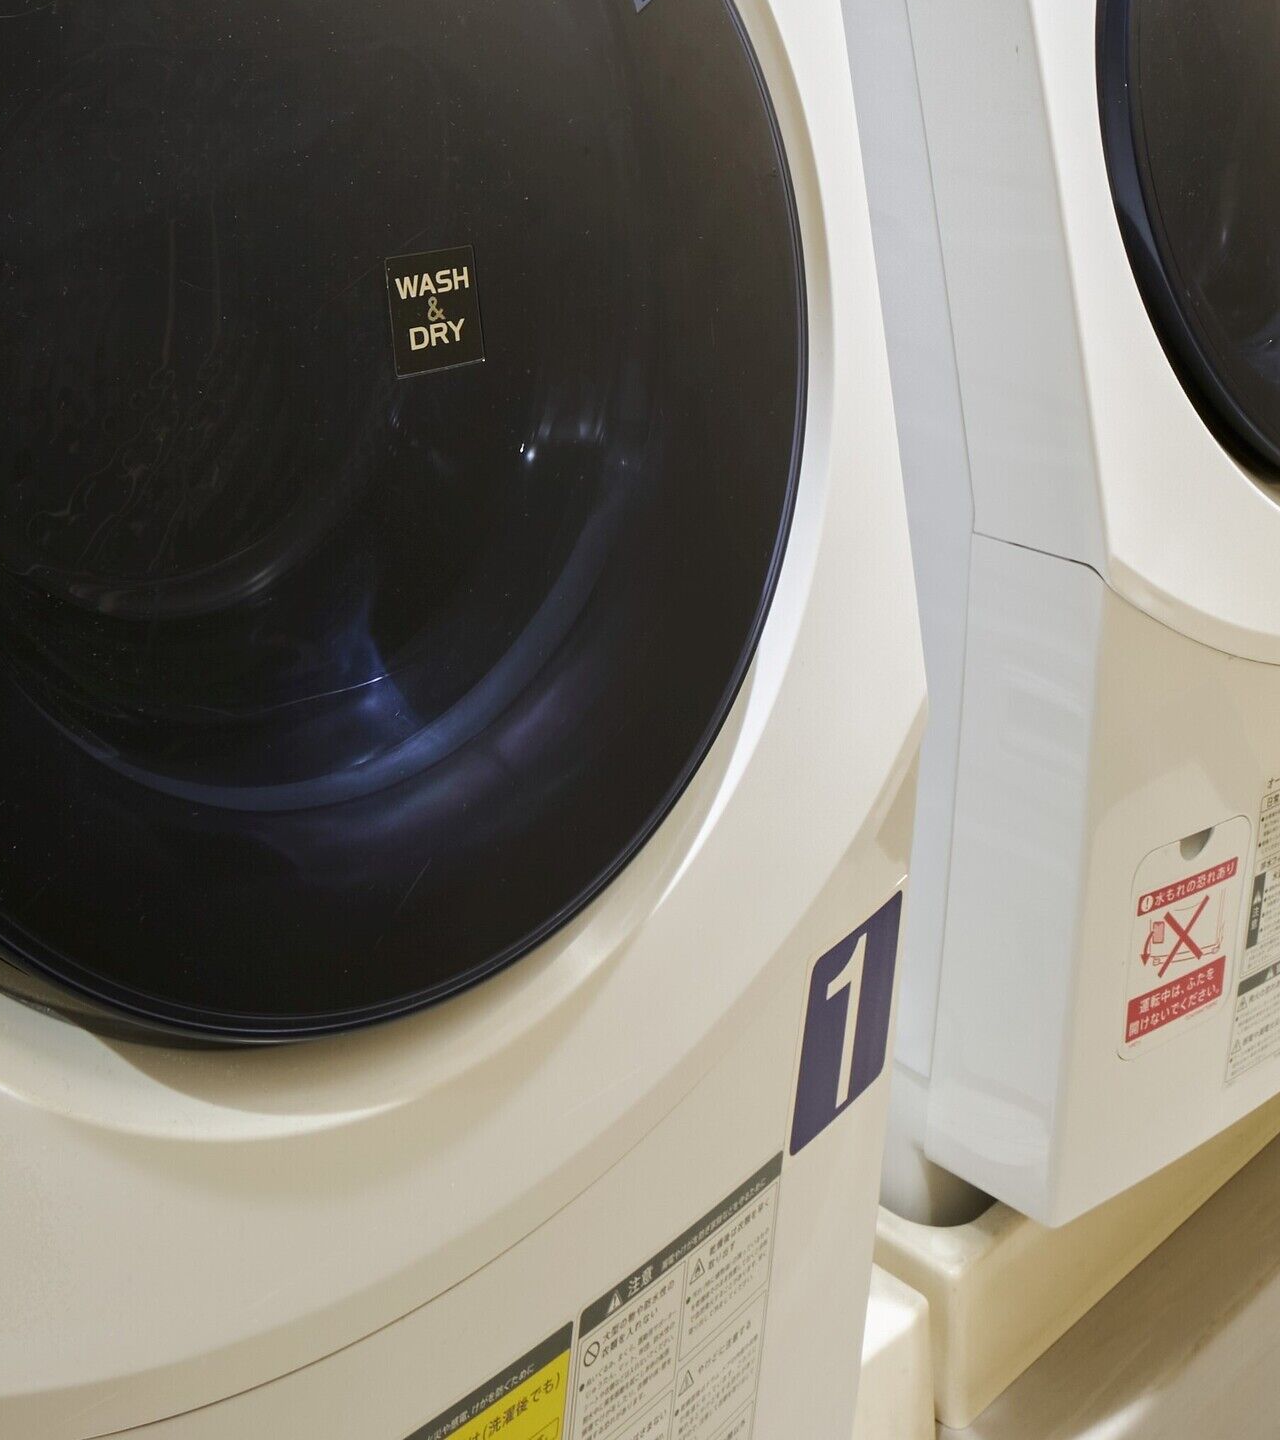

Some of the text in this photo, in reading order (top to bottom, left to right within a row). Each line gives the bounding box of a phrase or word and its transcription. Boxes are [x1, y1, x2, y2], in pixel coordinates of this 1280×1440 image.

[395, 266, 469, 299] WASH
[428, 296, 446, 322] &
[409, 318, 465, 351] DRY
[1154, 862, 1234, 905] 水もれの恐れあり
[824, 932, 867, 1109] 1
[1129, 984, 1220, 1036] 開けないでください。
